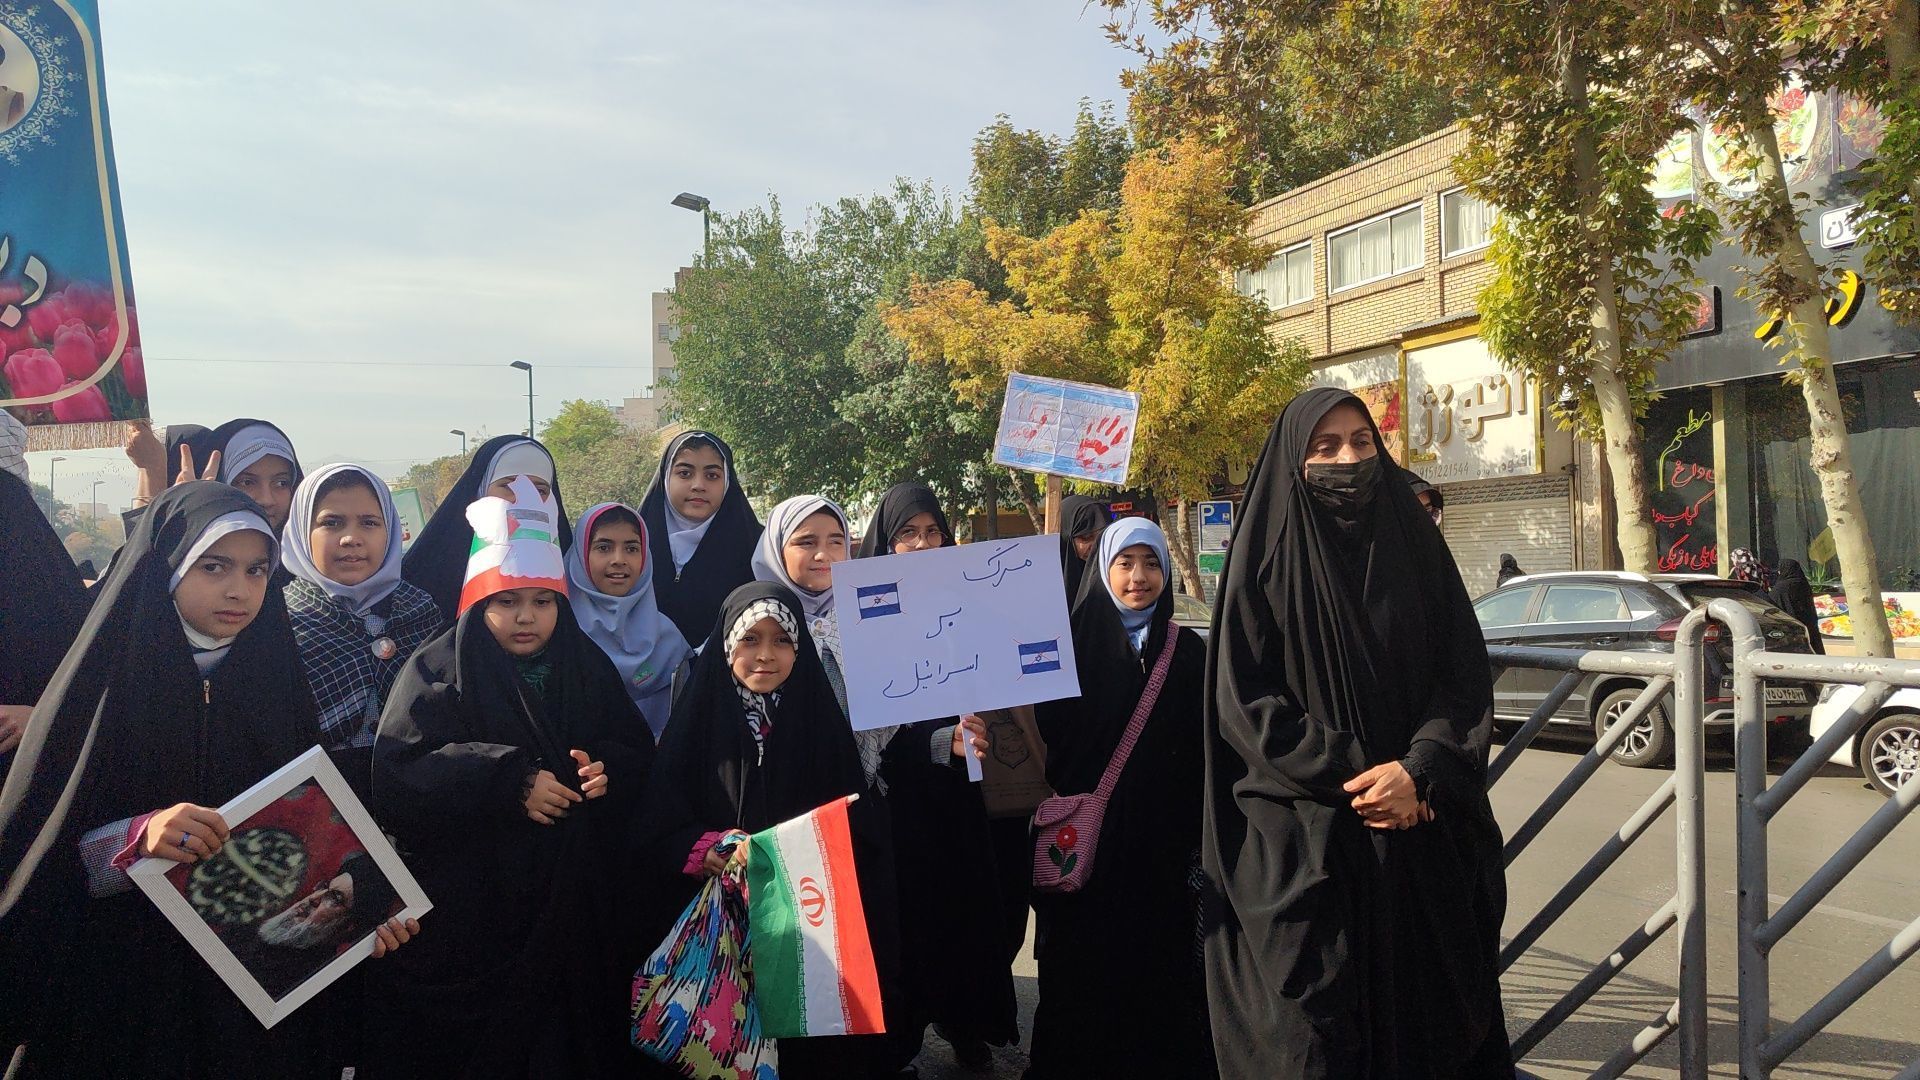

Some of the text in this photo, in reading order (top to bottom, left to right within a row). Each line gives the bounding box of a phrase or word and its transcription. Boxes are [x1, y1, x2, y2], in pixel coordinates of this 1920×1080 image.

[1201, 504, 1215, 525] P
[962, 542, 1033, 588] مرگ
[925, 606, 962, 640] بر
[882, 654, 979, 699] اسرائیل
